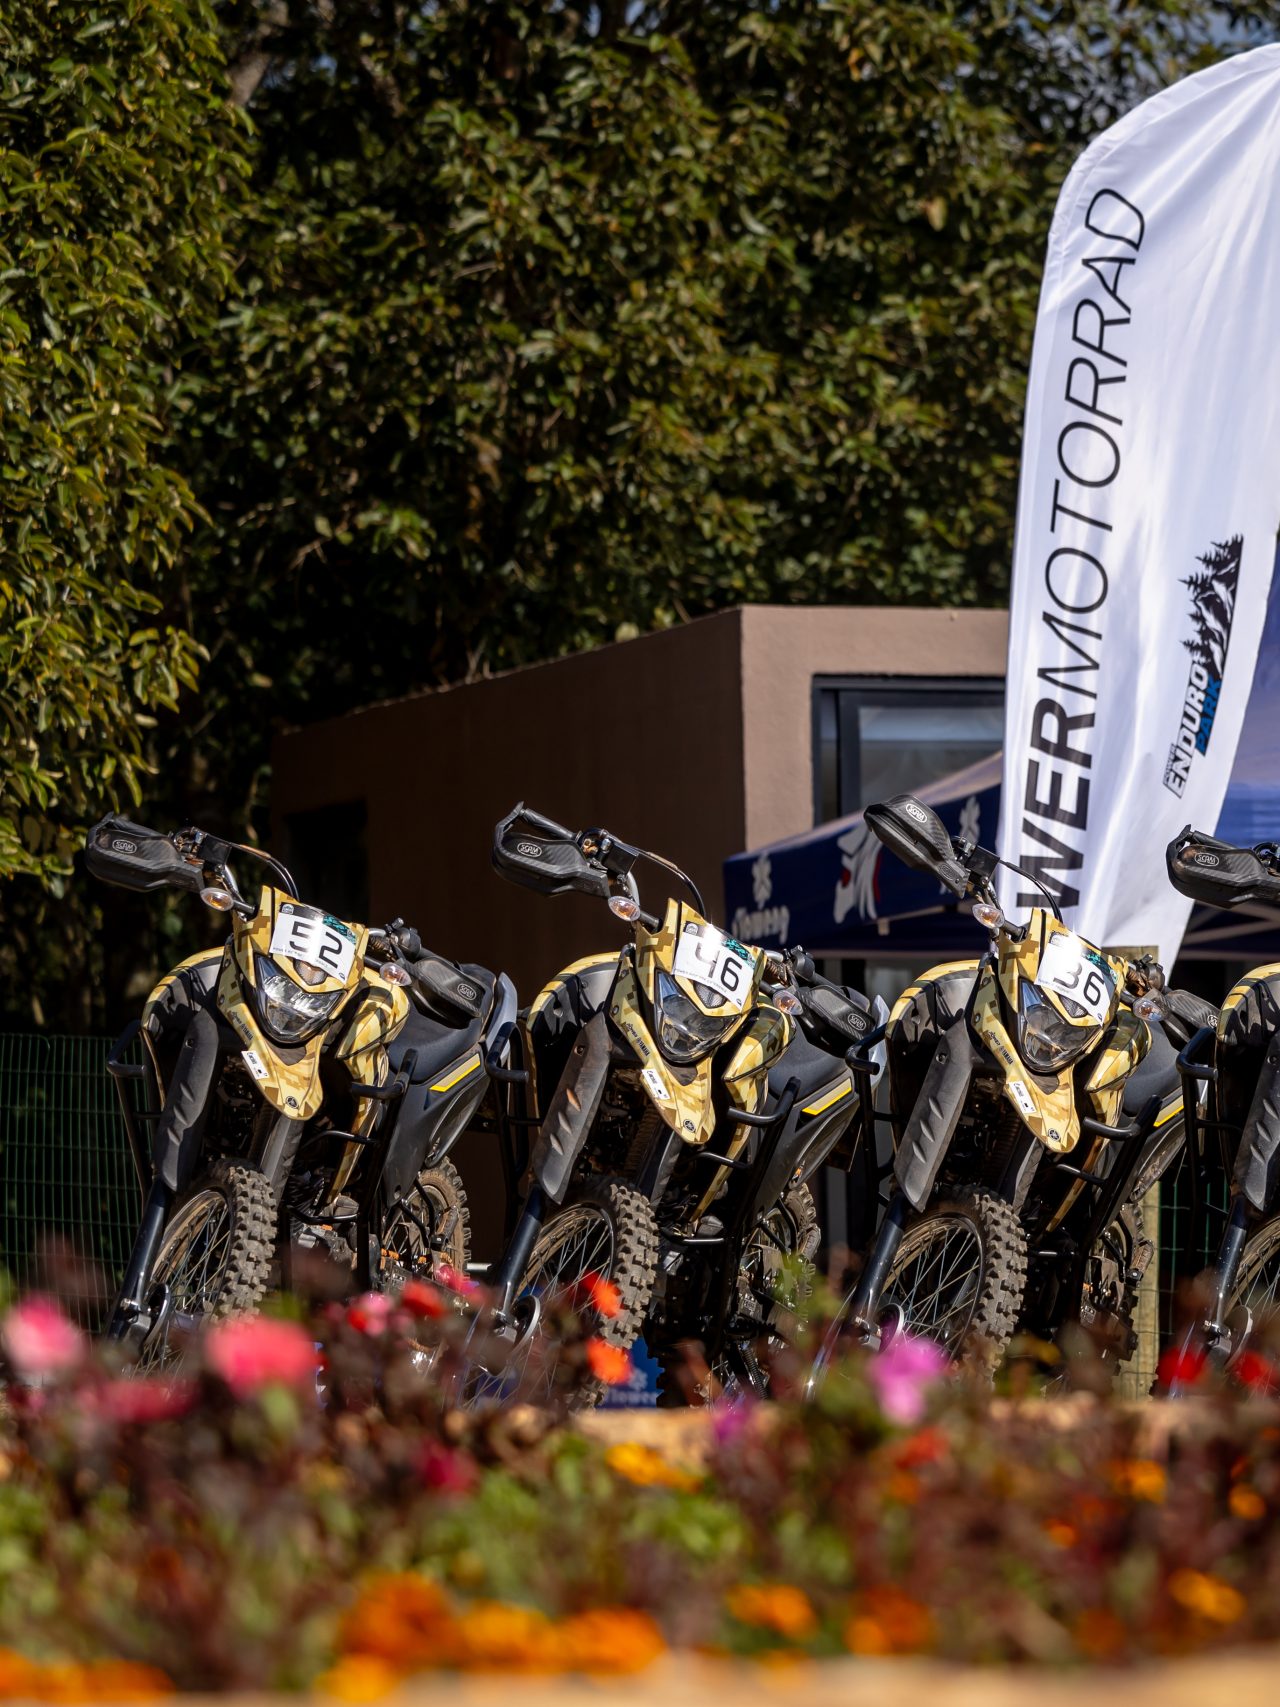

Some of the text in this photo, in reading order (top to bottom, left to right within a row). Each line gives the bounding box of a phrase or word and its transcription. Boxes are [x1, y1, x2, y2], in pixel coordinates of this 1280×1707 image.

[1166, 662, 1209, 799] ENDURO
[1195, 675, 1221, 757] PARK
[289, 920, 343, 969] 52
